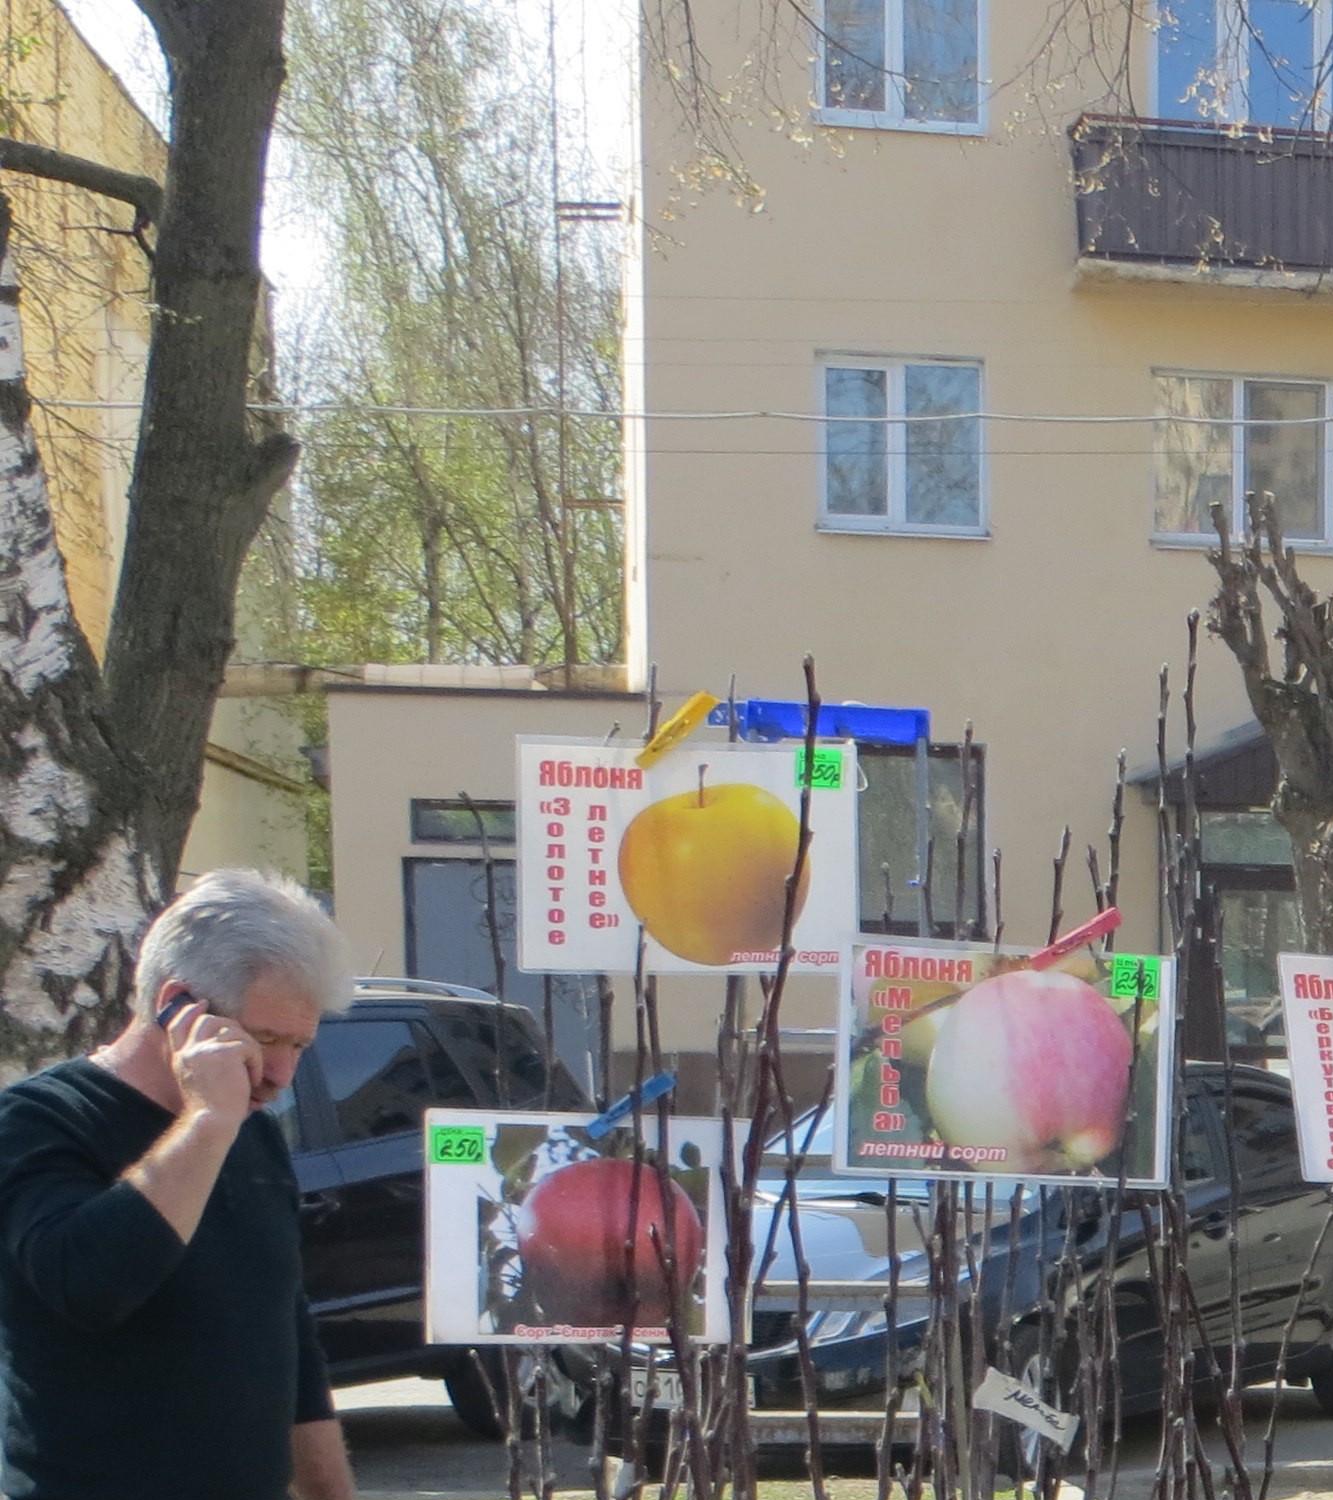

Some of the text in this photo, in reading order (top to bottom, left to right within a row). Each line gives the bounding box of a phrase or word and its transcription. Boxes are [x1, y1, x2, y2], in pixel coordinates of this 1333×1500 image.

[539, 760, 643, 790] Яблоня
[865, 949, 973, 983] Яблоня
[859, 1140, 1007, 1163] летний сорт
